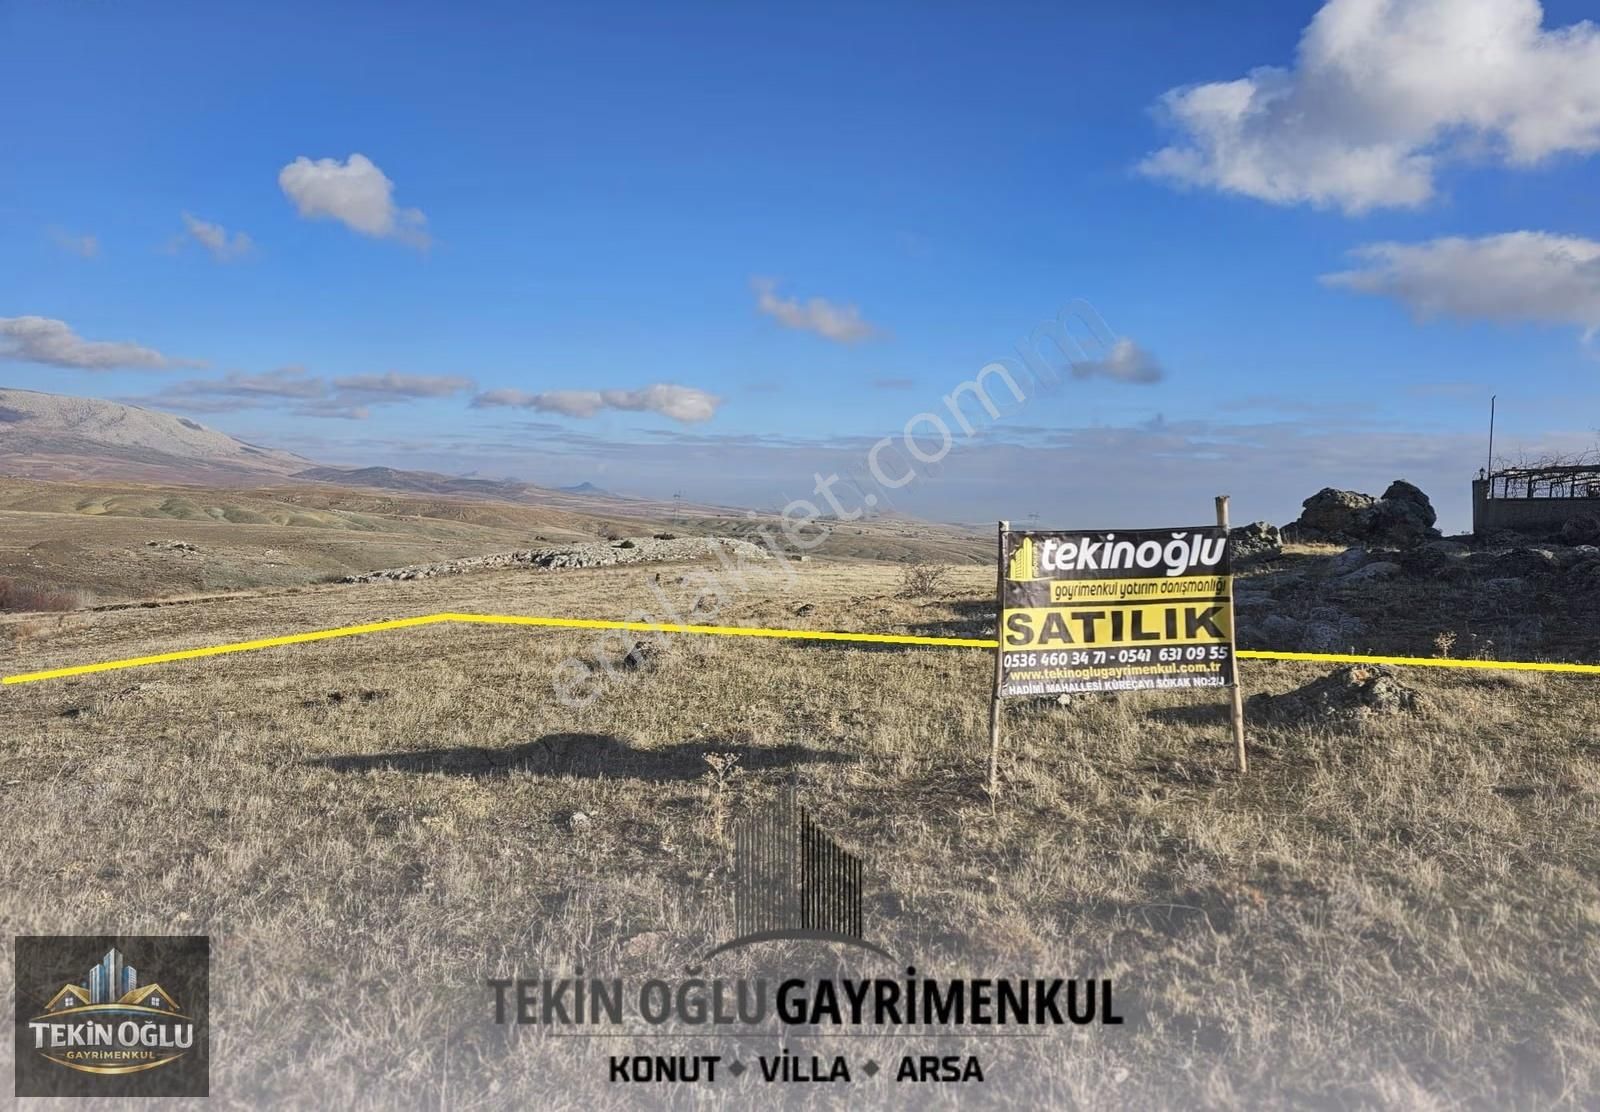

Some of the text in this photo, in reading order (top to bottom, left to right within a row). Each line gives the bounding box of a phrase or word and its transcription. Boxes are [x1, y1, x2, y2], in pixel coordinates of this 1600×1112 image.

[1041, 532, 1226, 576] tekinoğlu
[1055, 578, 1226, 600] gayrimenkul yatırım danışmanlığı
[1006, 606, 1226, 646] SATILIK
[1004, 653, 1037, 667] 0536
[1041, 652, 1068, 665] 460
[1071, 651, 1089, 665] 34
[1093, 650, 1106, 664] 71
[1118, 648, 1152, 663] 0541
[1159, 647, 1183, 661] 631
[1186, 646, 1205, 660] 09
[1209, 645, 1229, 659] 55
[1009, 662, 1222, 680] www.tekinoglugayrimenkul.com.tr
